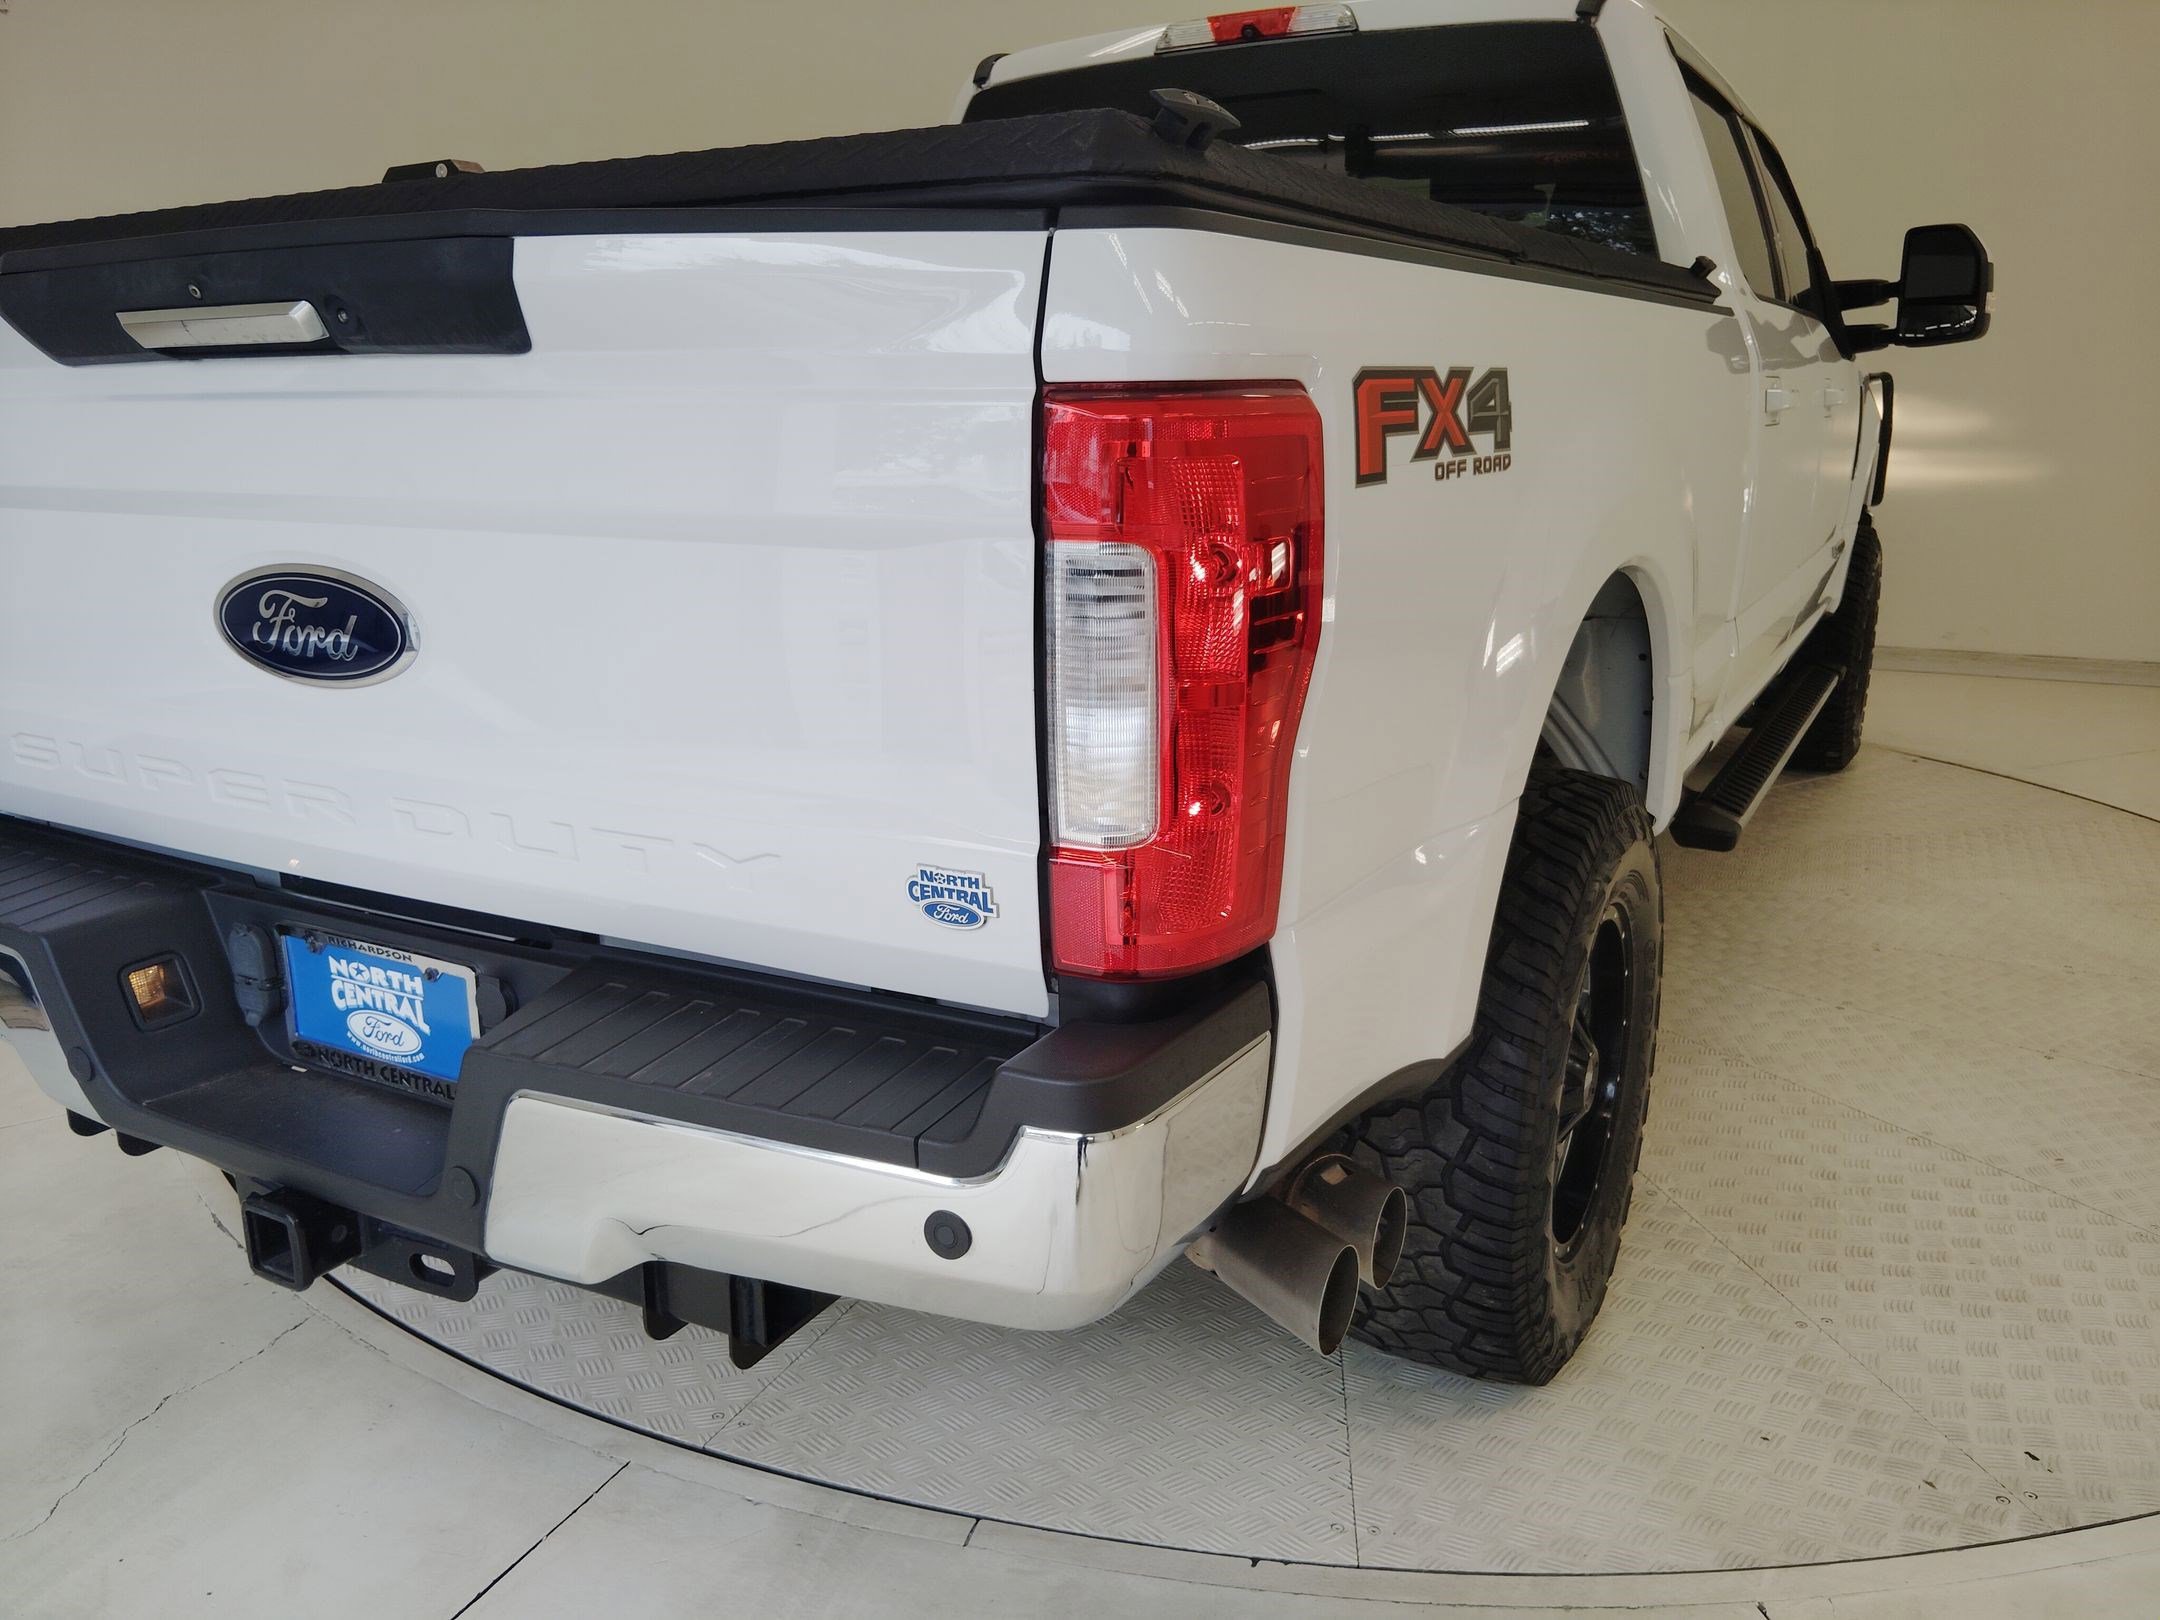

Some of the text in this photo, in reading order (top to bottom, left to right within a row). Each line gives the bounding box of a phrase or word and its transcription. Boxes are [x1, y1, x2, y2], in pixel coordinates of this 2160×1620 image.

[1352, 366, 1512, 488] FX4
[1435, 453, 1512, 481] OFF ROAD
[252, 589, 359, 662] Ford
[9, 731, 783, 894] SUPER DUTY
[907, 880, 994, 914] CENTRAL
[919, 869, 980, 890] NORTH
[933, 904, 969, 924] Ford
[327, 936, 413, 963] RICHARDSON
[328, 955, 424, 996] NORTH
[331, 979, 431, 1036] CENTRAL
[362, 1016, 404, 1047] Ford
[318, 1047, 456, 1101] NORTH CENTRAL
